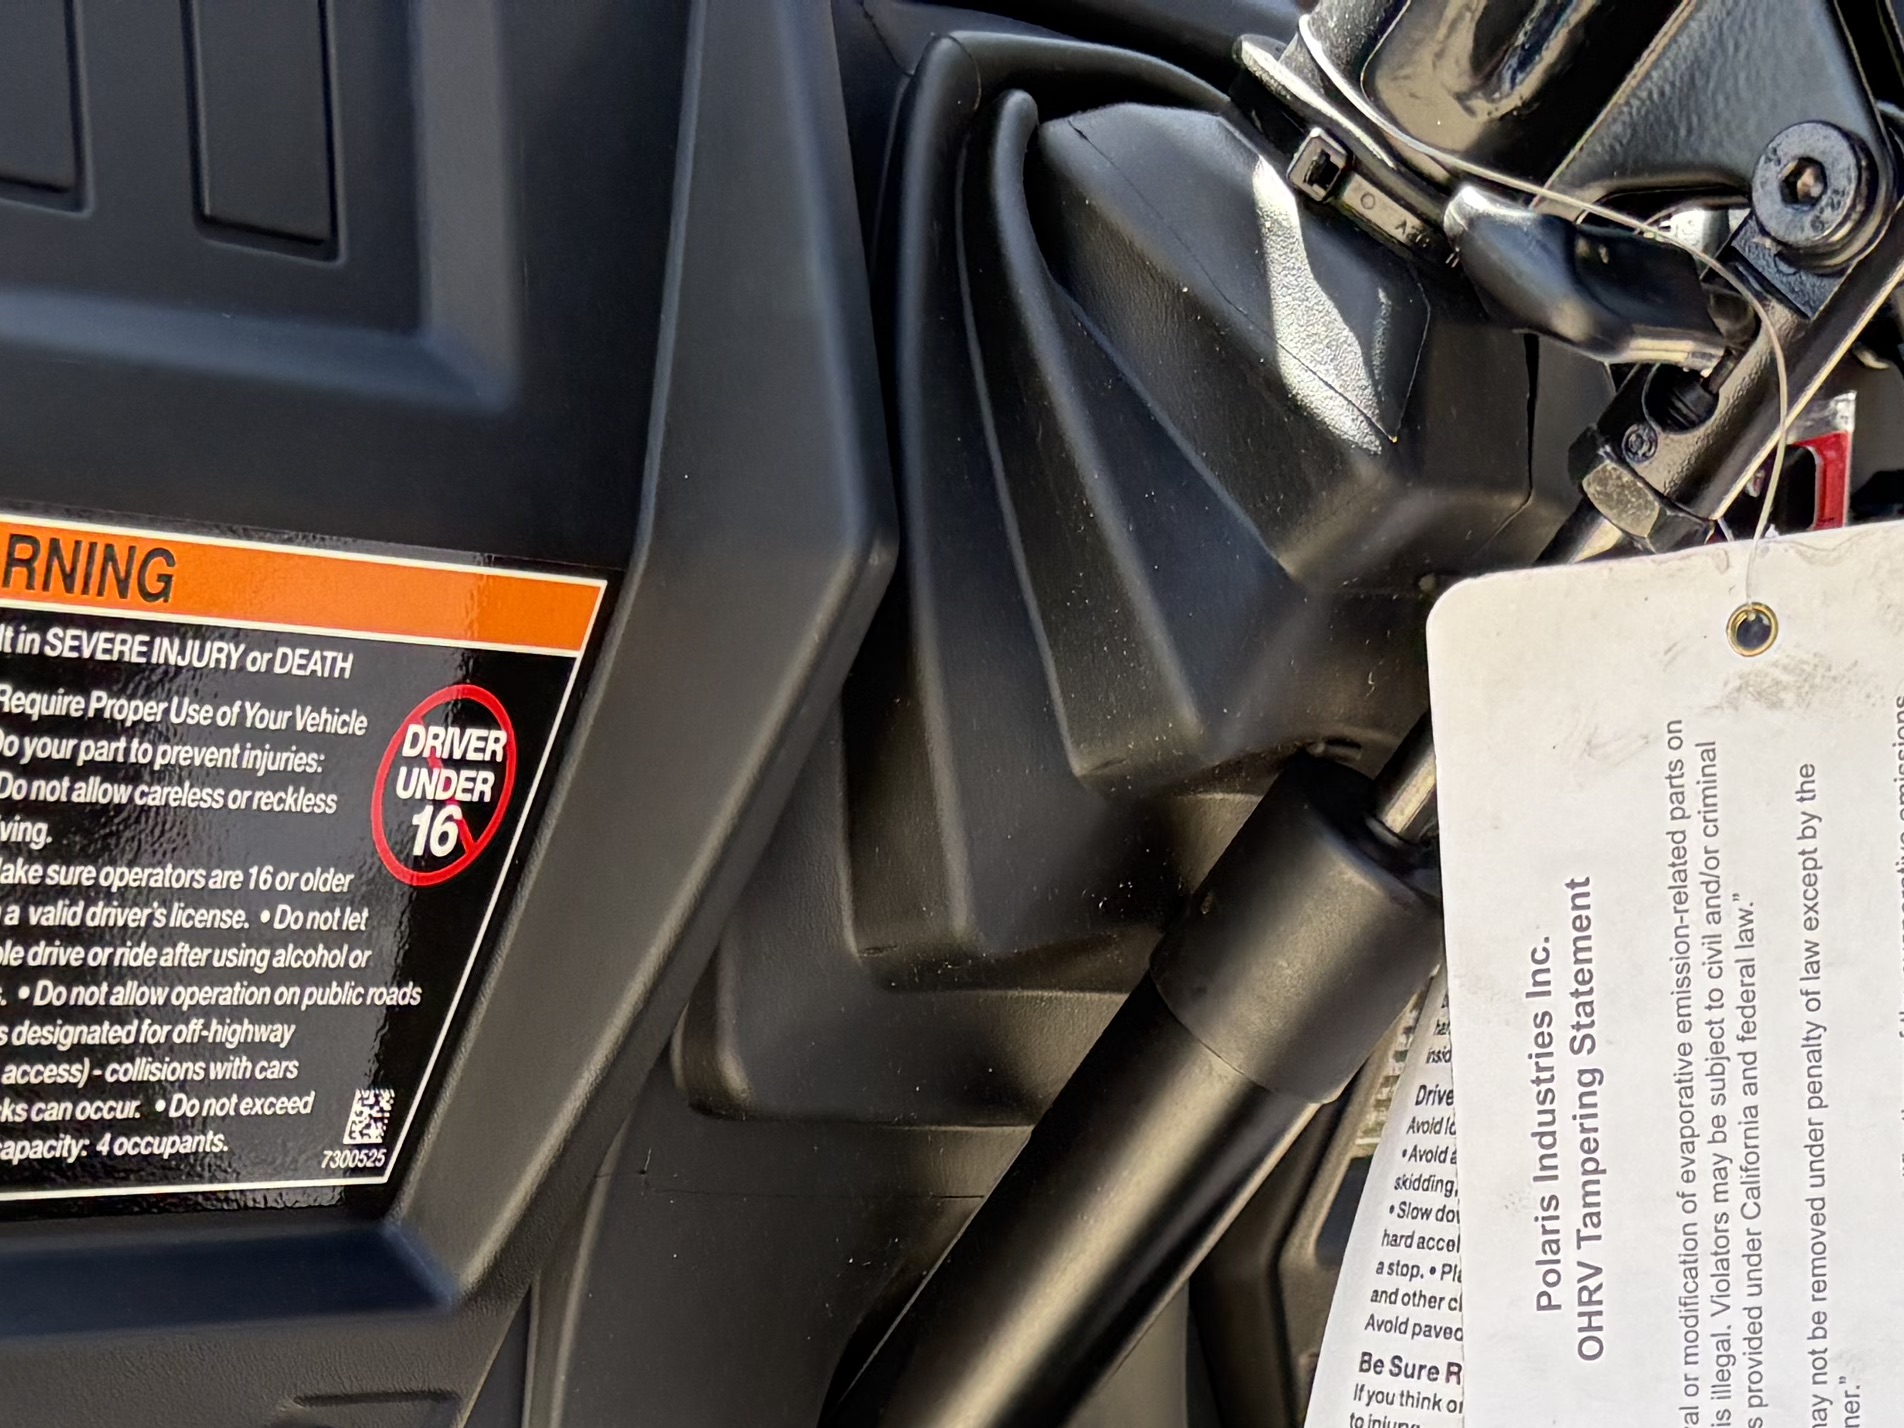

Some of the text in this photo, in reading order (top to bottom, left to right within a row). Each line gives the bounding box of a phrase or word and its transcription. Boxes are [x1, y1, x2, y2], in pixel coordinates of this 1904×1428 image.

[14, 624, 42, 655] in
[43, 626, 151, 664] SEVERE
[150, 635, 246, 670] INJURY
[245, 650, 273, 673] or
[272, 646, 354, 679] DEATH
[86, 689, 169, 727] Proper
[168, 695, 214, 726] Use
[215, 699, 242, 727] of
[244, 700, 293, 730] Your
[295, 703, 368, 736] Vehicle
[18, 735, 79, 765] your
[75, 735, 128, 767] part
[127, 736, 154, 764] to
[152, 742, 241, 772] prevent
[241, 742, 325, 777] injuries:
[401, 723, 508, 764] DRIVER
[28, 775, 71, 802] not
[70, 775, 134, 805] allow
[132, 780, 225, 811] careless
[226, 788, 253, 810] or
[251, 785, 338, 814] reckless
[395, 764, 496, 803] UNDER
[1694, 740, 1720, 838] criminal
[410, 803, 462, 858] 16
[1697, 845, 1722, 925] and/or
[1700, 933, 1724, 980] civil
[1703, 987, 1725, 1011] to
[1734, 957, 1757, 1043] federal
[1703, 1016, 1731, 1106] subject
[1735, 1050, 1759, 1096] and
[1414, 1084, 1455, 1107] Drive
[1564, 876, 1607, 1361] OHRV Tampering Statement
[1524, 936, 1562, 1312] Polaris Industries Inc.
[1706, 1113, 1727, 1144] be
[319, 1146, 387, 1171] 7300525
[1711, 1152, 1734, 1203] may
[1738, 1104, 1761, 1220] California
[1396, 1200, 1432, 1222] Slow
[1709, 1211, 1731, 1318] Violators
[1740, 1227, 1763, 1297] under
[1358, 1351, 1440, 1382] Be Sure
[1710, 1324, 1737, 1400] illegal.
[1741, 1305, 1769, 1409] provided
[1715, 1408, 1732, 1427] is
